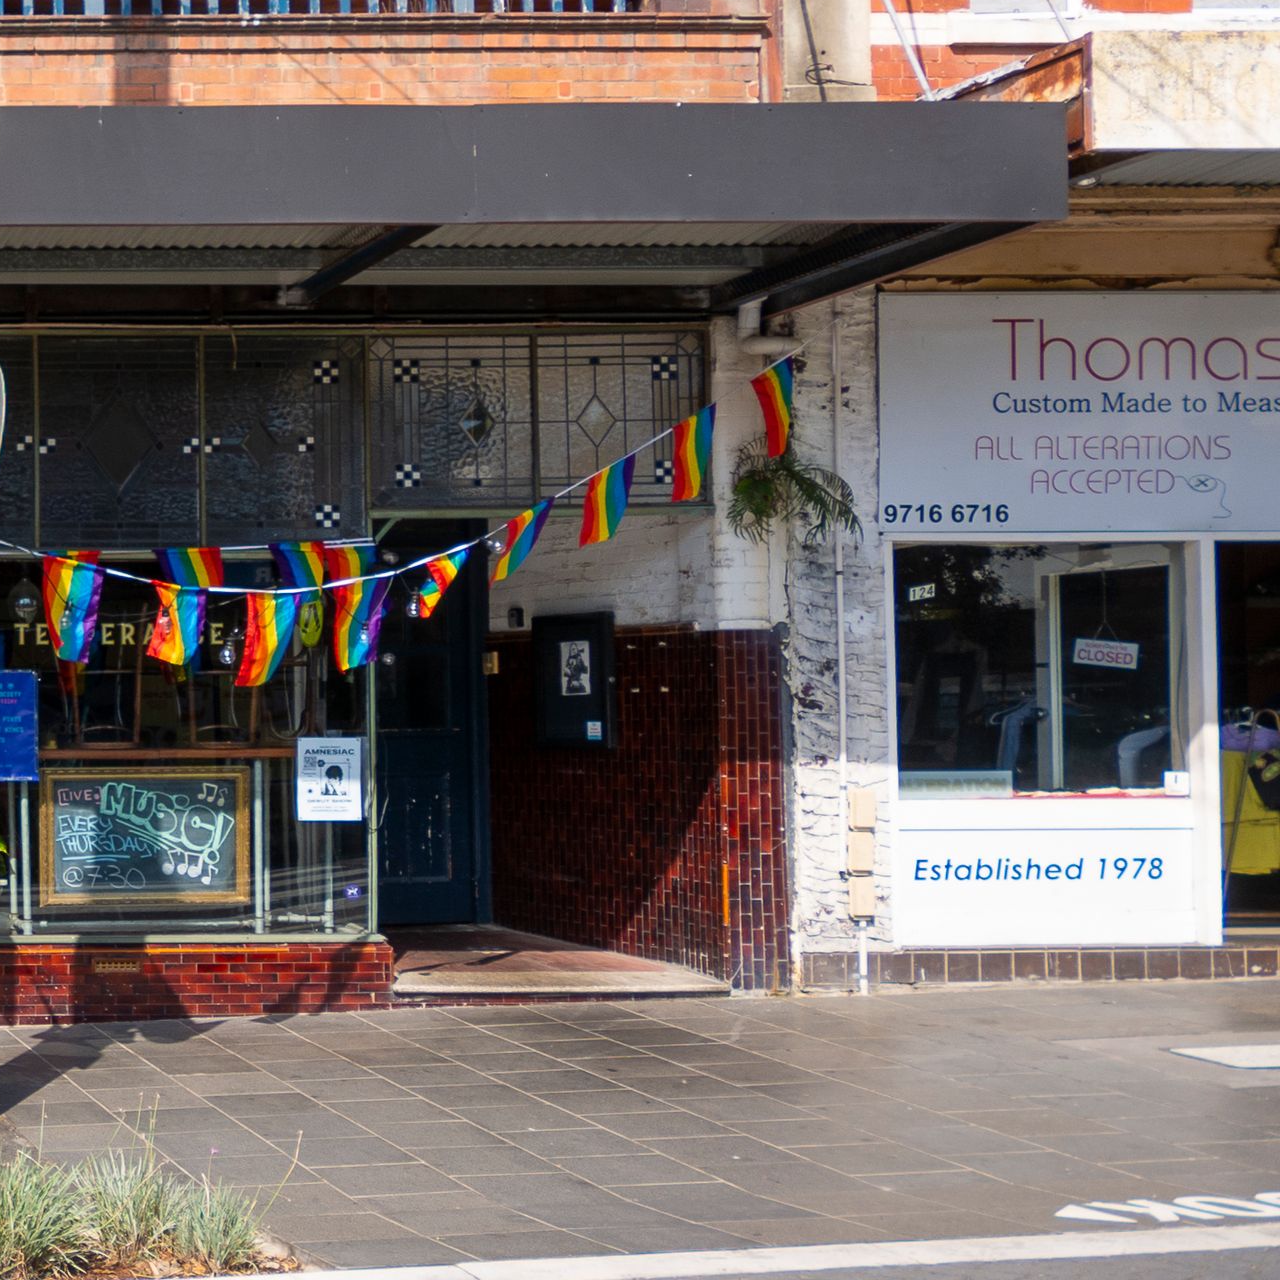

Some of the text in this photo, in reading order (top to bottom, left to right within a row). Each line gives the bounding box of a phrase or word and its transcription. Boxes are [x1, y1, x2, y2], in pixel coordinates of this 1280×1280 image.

[992, 392, 1092, 414] Custom
[1101, 392, 1172, 414] Made
[1182, 394, 1208, 413] to
[975, 435, 1232, 461] ALL ALTERATIONS
[1030, 469, 1176, 495] ACCEPTED
[884, 505, 1010, 523] 9716 6716
[910, 585, 935, 600] 124
[13, 622, 224, 645] TEERAE
[1077, 648, 1134, 665] CLOSED
[57, 815, 113, 834] EVERY
[913, 857, 1164, 882] Established 1978
